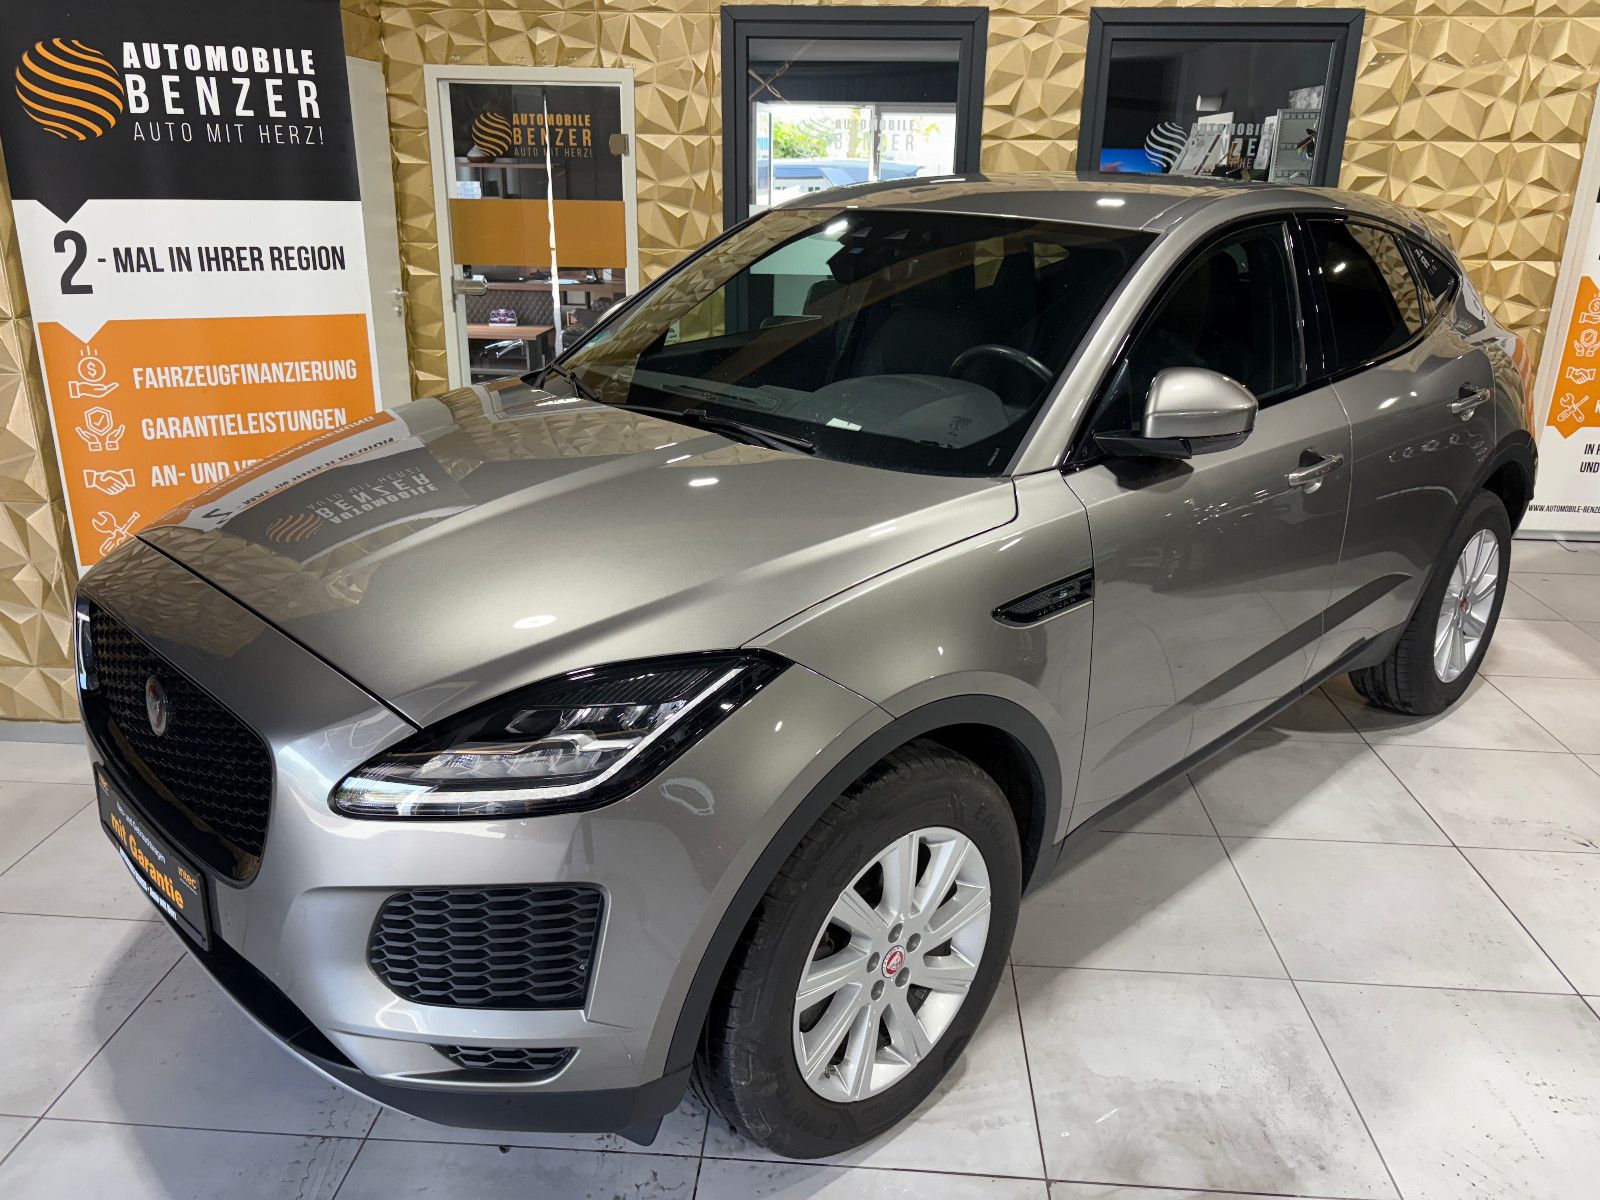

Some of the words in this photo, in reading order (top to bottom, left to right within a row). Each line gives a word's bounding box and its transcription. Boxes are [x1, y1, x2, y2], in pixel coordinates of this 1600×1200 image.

[122, 41, 316, 76] AUTOMOBILE
[124, 73, 321, 119] BENZER
[133, 121, 193, 142] AUTO
[207, 123, 245, 144] MIT
[259, 125, 325, 145] HERZ!
[512, 113, 591, 127] AUTOMOBILE
[514, 147, 539, 157] AUTO
[564, 148, 593, 158] HERZ!
[113, 247, 165, 273] MAL
[169, 246, 192, 272] IN
[199, 246, 266, 272] IHRER
[271, 245, 346, 271] REGION
[133, 359, 357, 389] FAHRZEUGFINANZIERUNG
[141, 408, 347, 441] GARANTIELEISTUNGEN
[1584, 443, 1595, 455] IN
[151, 464, 186, 488] AN-
[190, 461, 231, 485] UND
[111, 813, 128, 846] mit
[129, 834, 184, 909] Garantie
